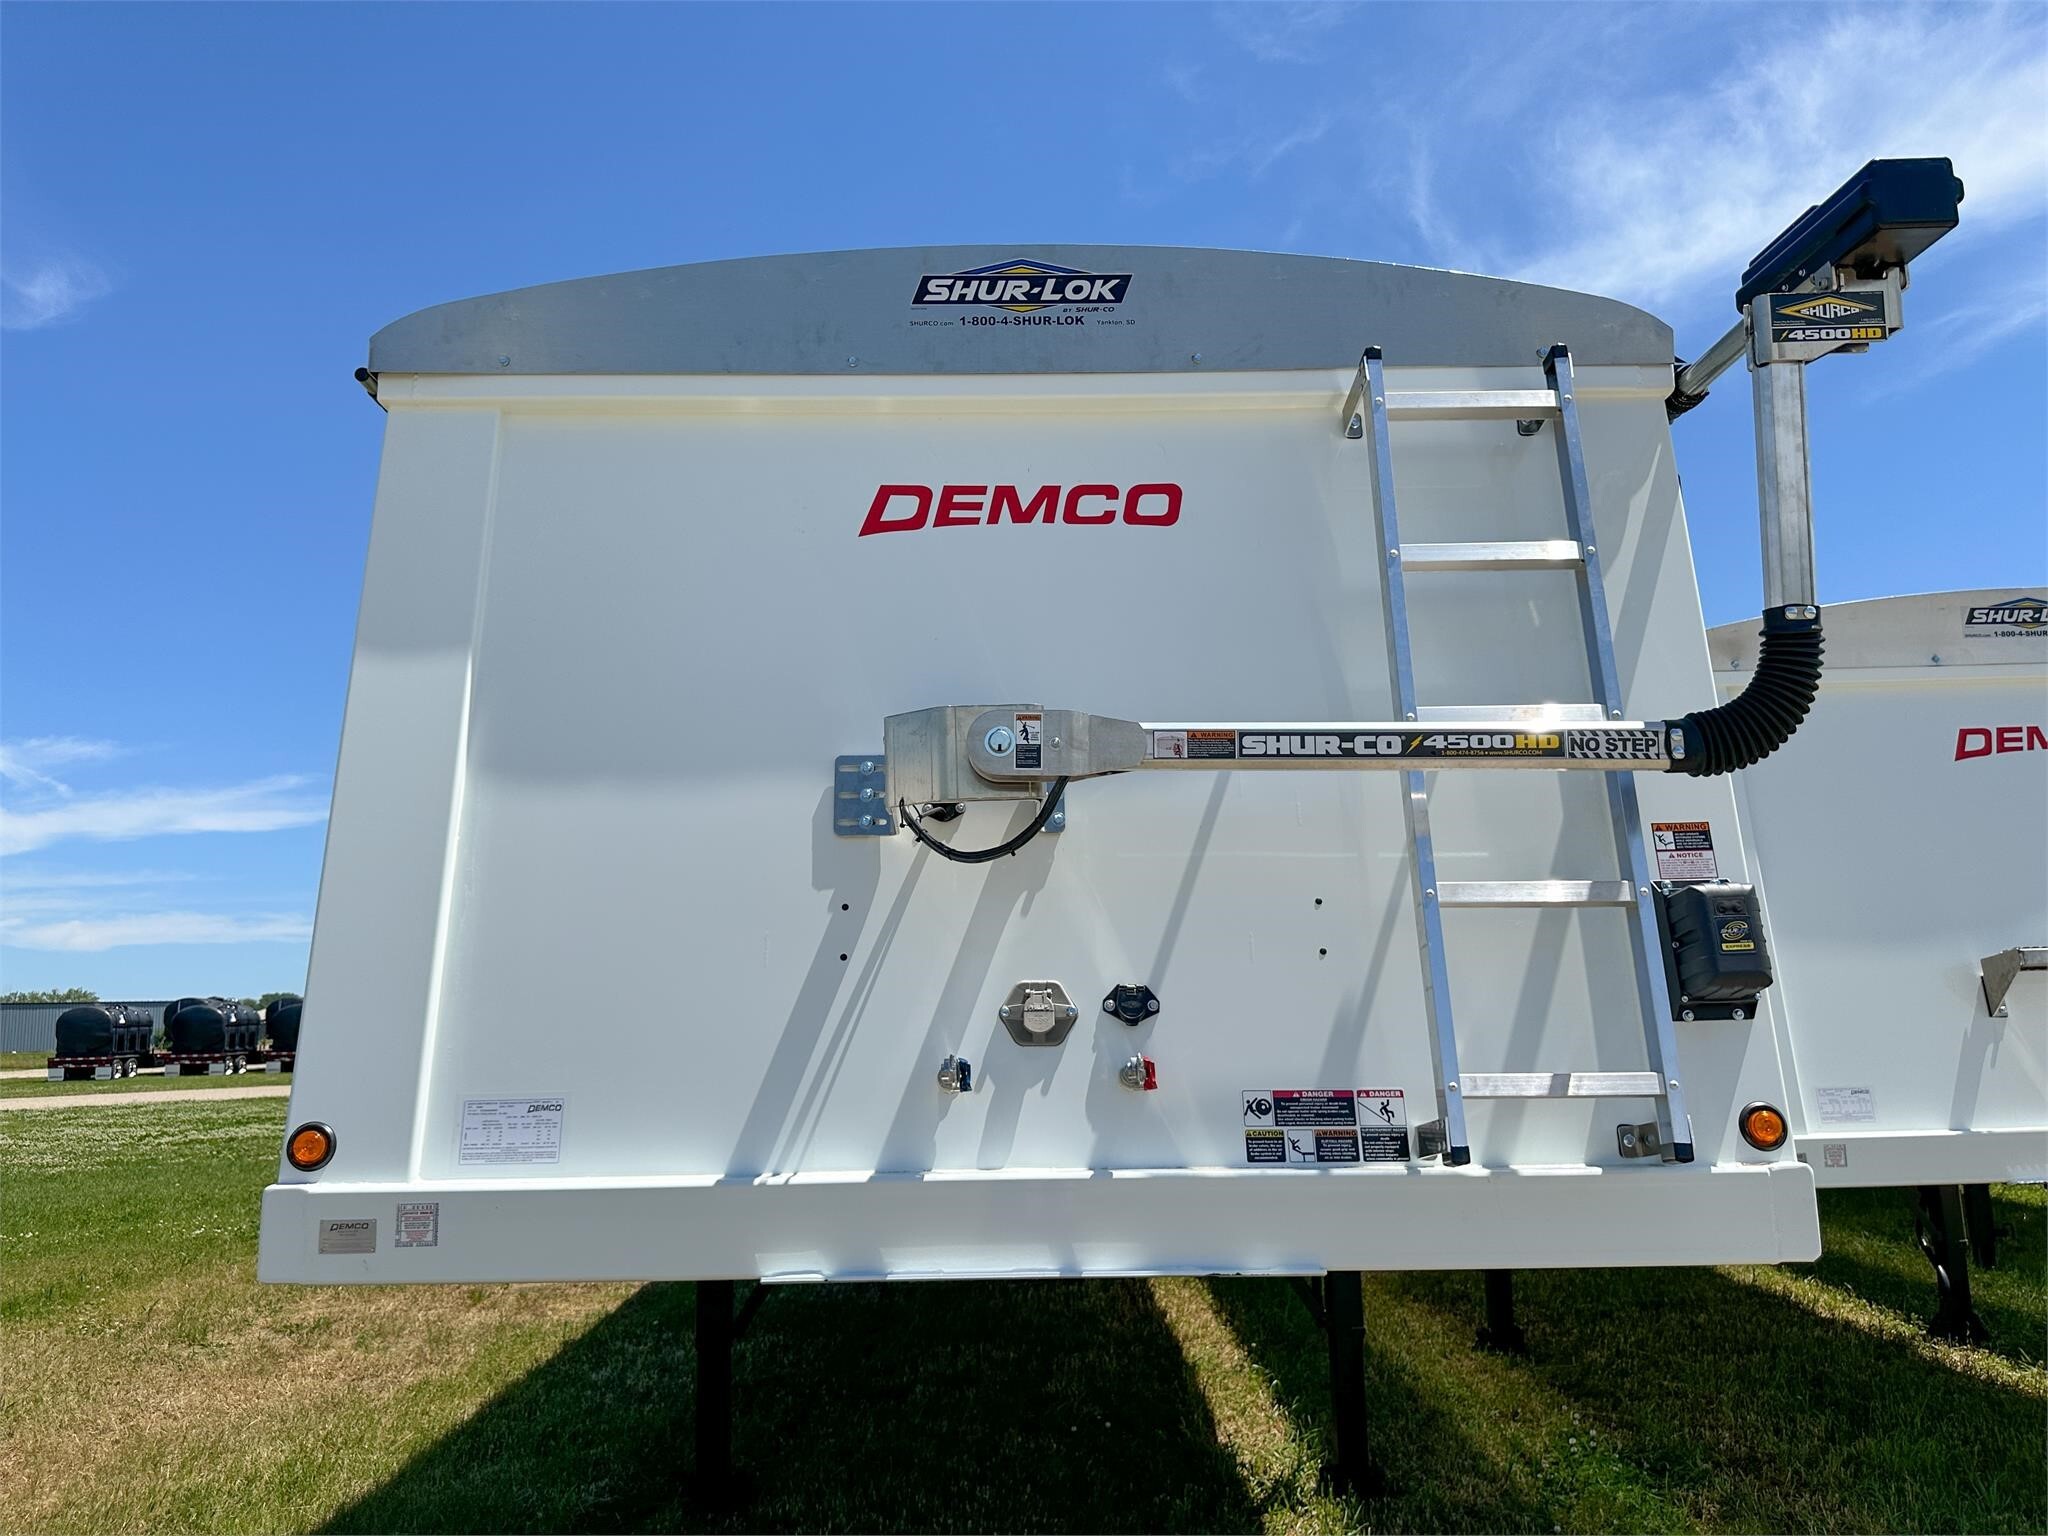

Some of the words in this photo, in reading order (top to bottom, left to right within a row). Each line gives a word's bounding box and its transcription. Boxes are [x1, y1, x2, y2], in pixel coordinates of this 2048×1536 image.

[922, 278, 1122, 301] SHUR-LOK
[1799, 303, 1860, 319] SHURCO
[959, 316, 1085, 326] 1-800-4-SHUR-LOK
[1787, 327, 1882, 340] 4500HD
[858, 483, 1183, 538] DEMCO
[1241, 735, 1403, 755] SHUR-CO
[1422, 734, 1560, 749] 4500HD
[1569, 737, 1600, 752] NO
[1605, 738, 1657, 753] STEP
[1665, 823, 1707, 831] WARNING
[1676, 851, 1703, 859] NOTICE
[526, 1103, 563, 1114] DEMCO
[1321, 1129, 1357, 1137] WARNING
[329, 1222, 370, 1232] DEMCO
